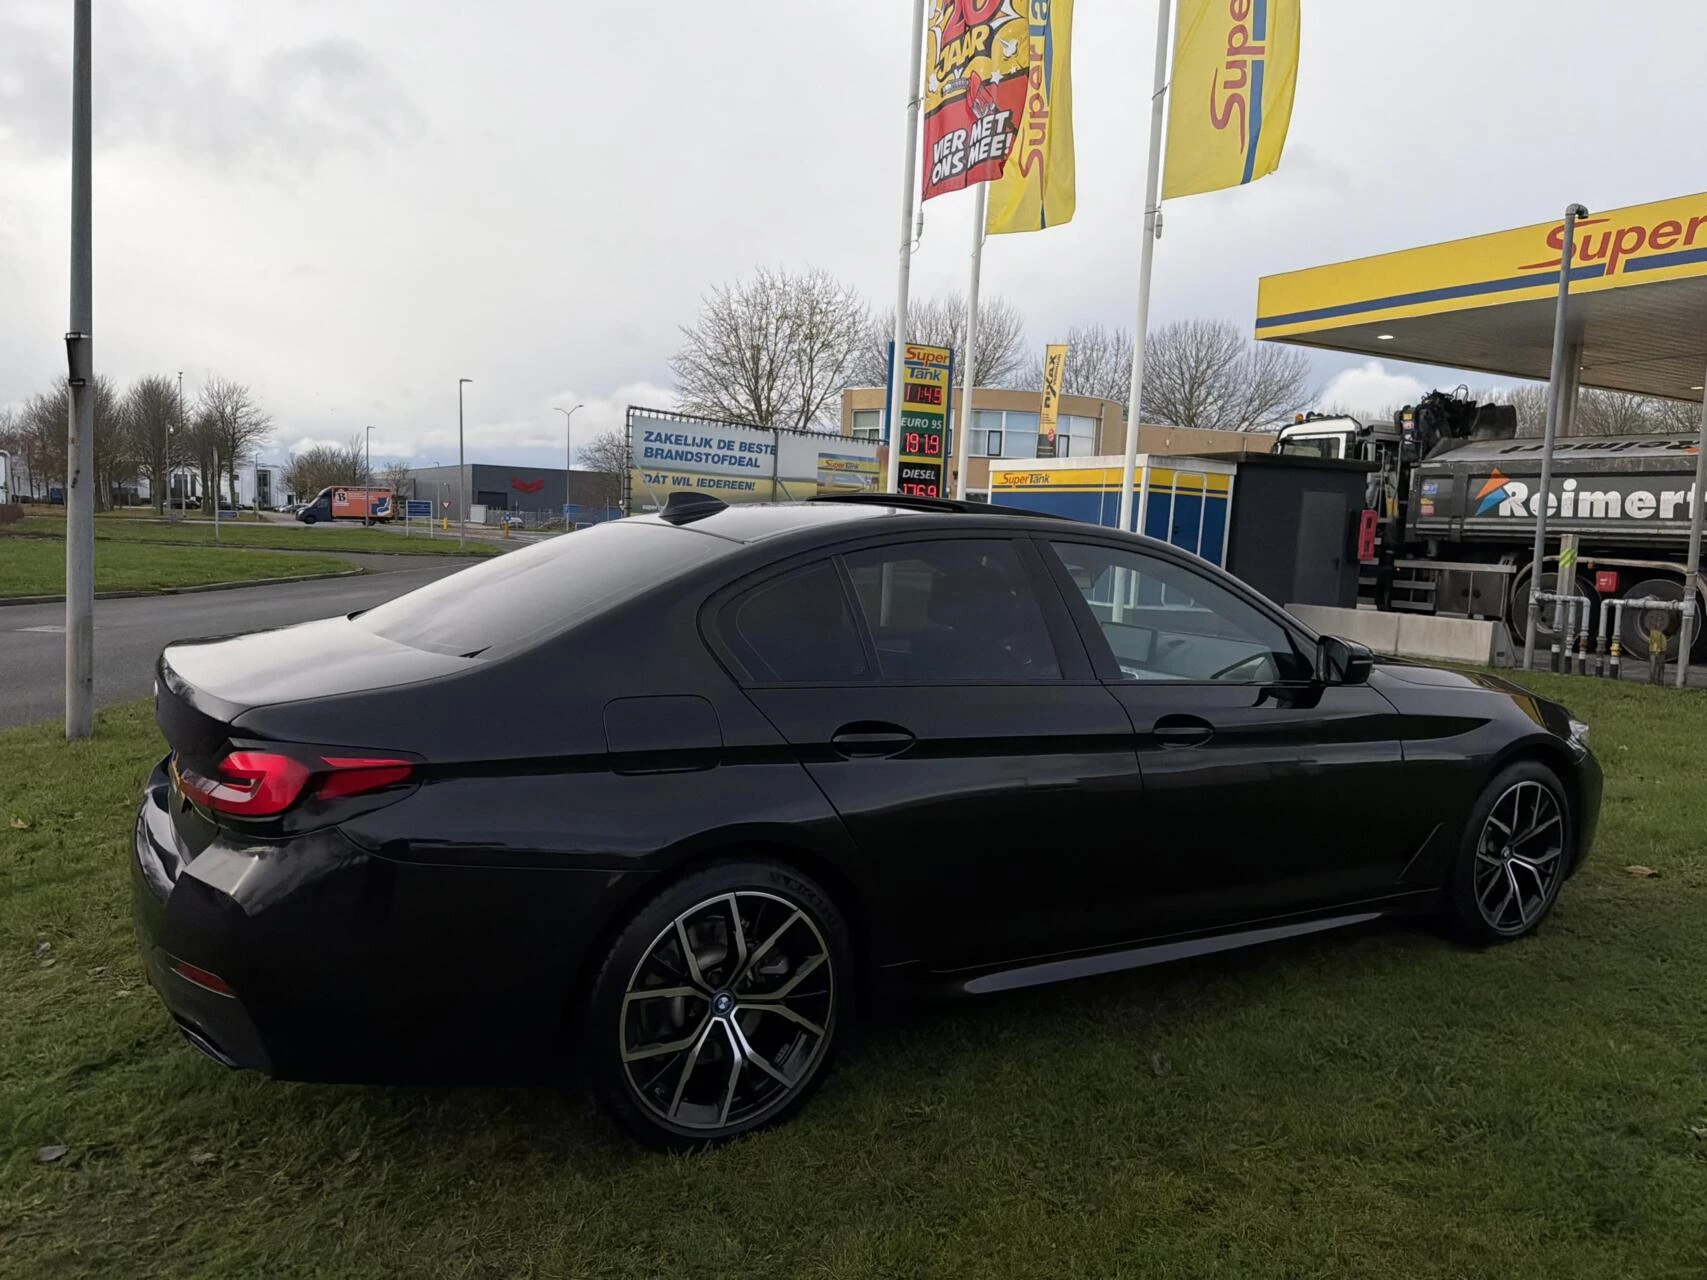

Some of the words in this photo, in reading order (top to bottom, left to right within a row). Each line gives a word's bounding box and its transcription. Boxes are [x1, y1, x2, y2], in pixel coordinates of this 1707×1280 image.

[937, 24, 990, 80] JAAR
[933, 128, 967, 162] VIER
[970, 110, 1012, 146] MET
[932, 150, 965, 185] ONS
[968, 132, 1013, 169] MEE!
[904, 346, 949, 368] Super
[906, 366, 942, 382] Tank
[901, 417, 929, 428] EURO
[931, 420, 943, 429] 95
[643, 430, 713, 449] ZAKELIJK
[717, 438, 736, 451] DE
[738, 441, 777, 456] BESTE
[643, 446, 761, 469] BRANDSTOFDEAL
[672, 475, 692, 487] WIL
[696, 478, 756, 492] IEDEREEN!
[902, 468, 936, 480] DIESEL
[999, 472, 1050, 488] SuperTank
